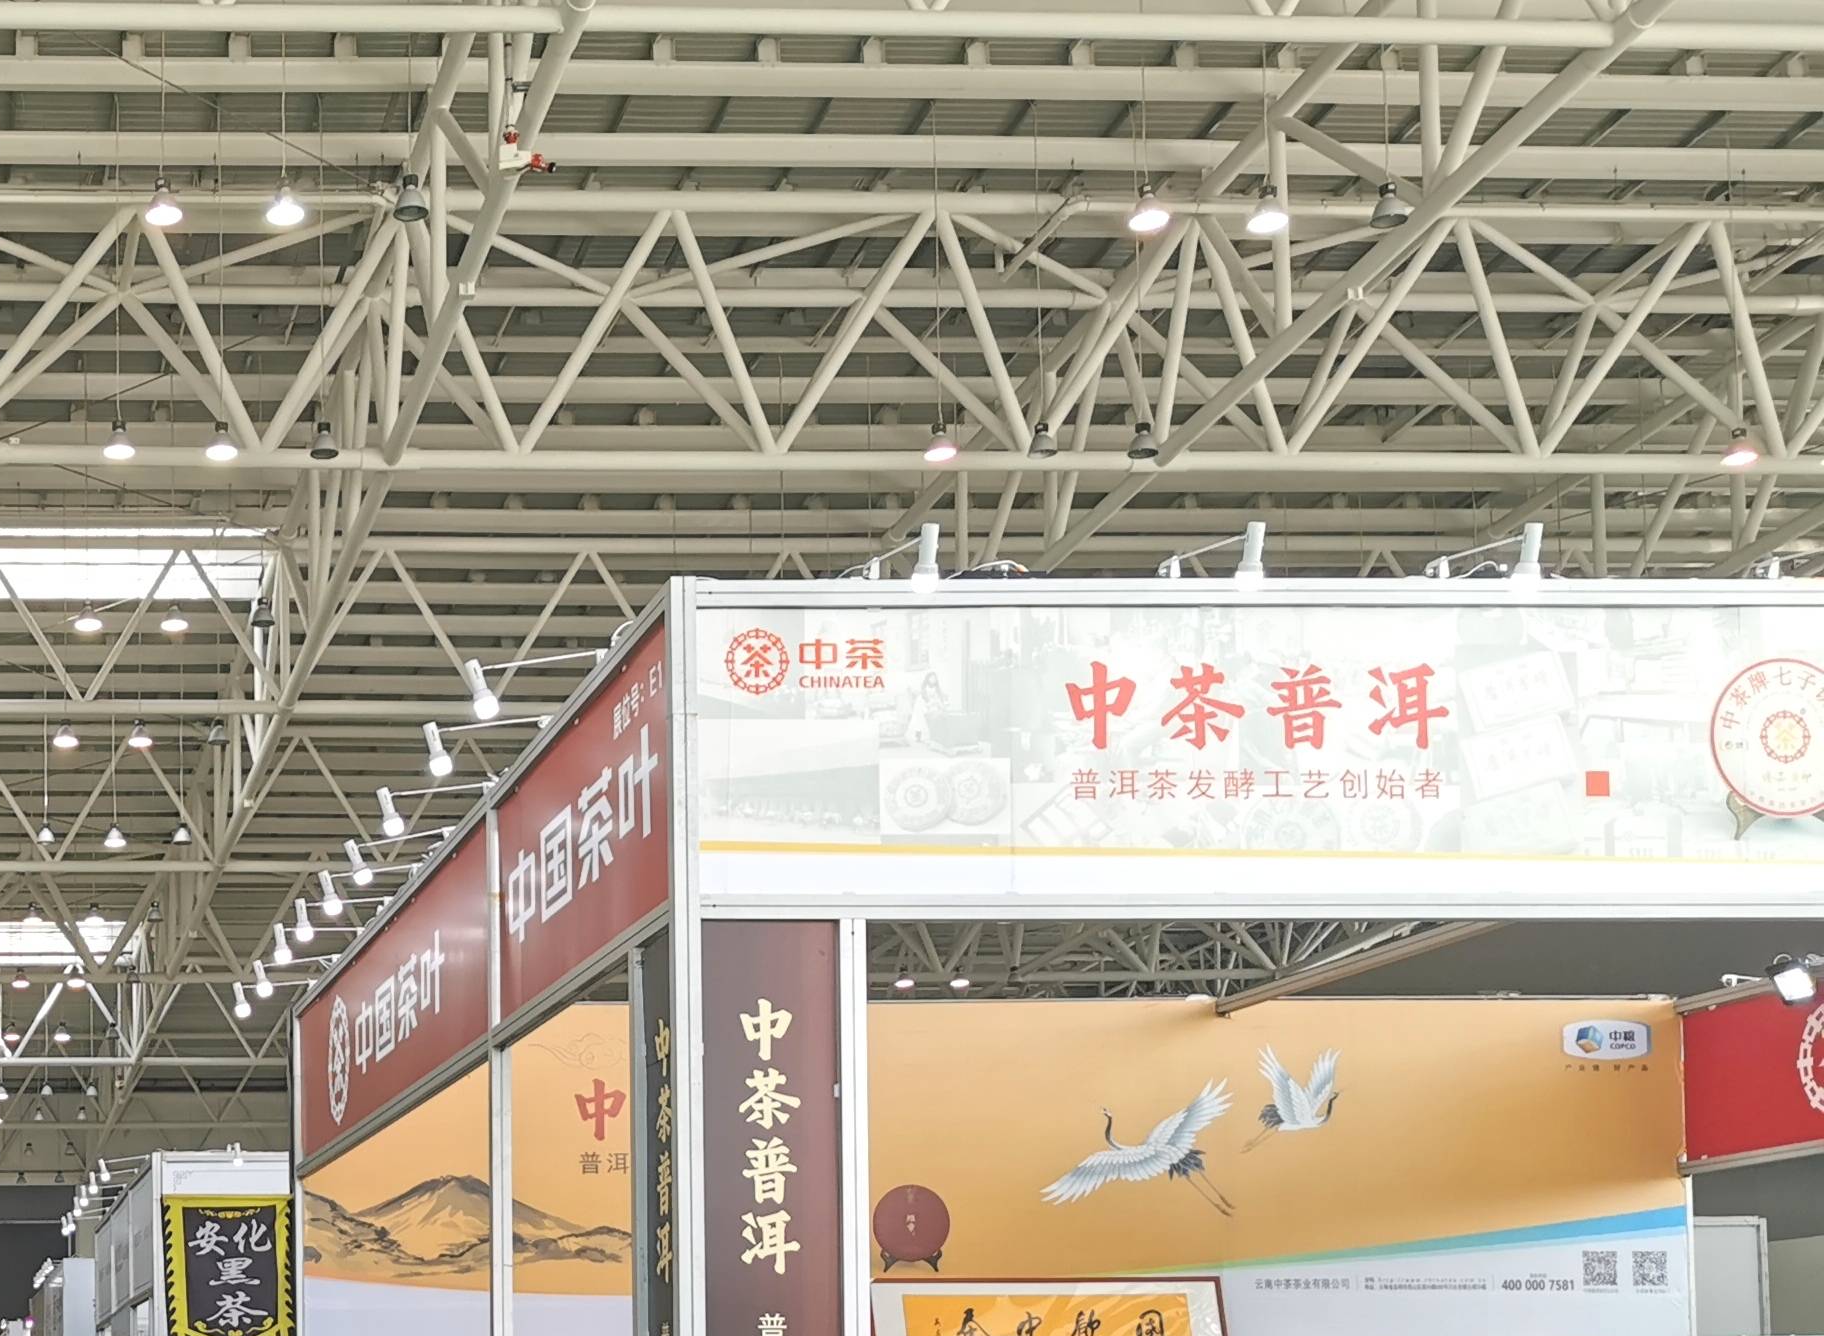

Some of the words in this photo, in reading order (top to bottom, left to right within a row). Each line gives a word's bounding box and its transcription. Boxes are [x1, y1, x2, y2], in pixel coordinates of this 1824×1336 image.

[798, 638, 885, 671] 中茶
[798, 675, 886, 689] CHINATEA
[1064, 660, 1450, 751] 中茶普洱
[1070, 767, 1445, 801] 普洱茶发酵工艺创始者
[508, 722, 659, 945] 中国茶叶
[354, 928, 446, 1076] 中国茶叶
[654, 1018, 673, 1284] 中茶普洱
[738, 997, 802, 1276] 中茶普洱
[187, 1218, 273, 1257] 安化
[1501, 1279, 1522, 1291] 400
[1525, 1279, 1546, 1291] 000
[1549, 1279, 1575, 1291] 7581
